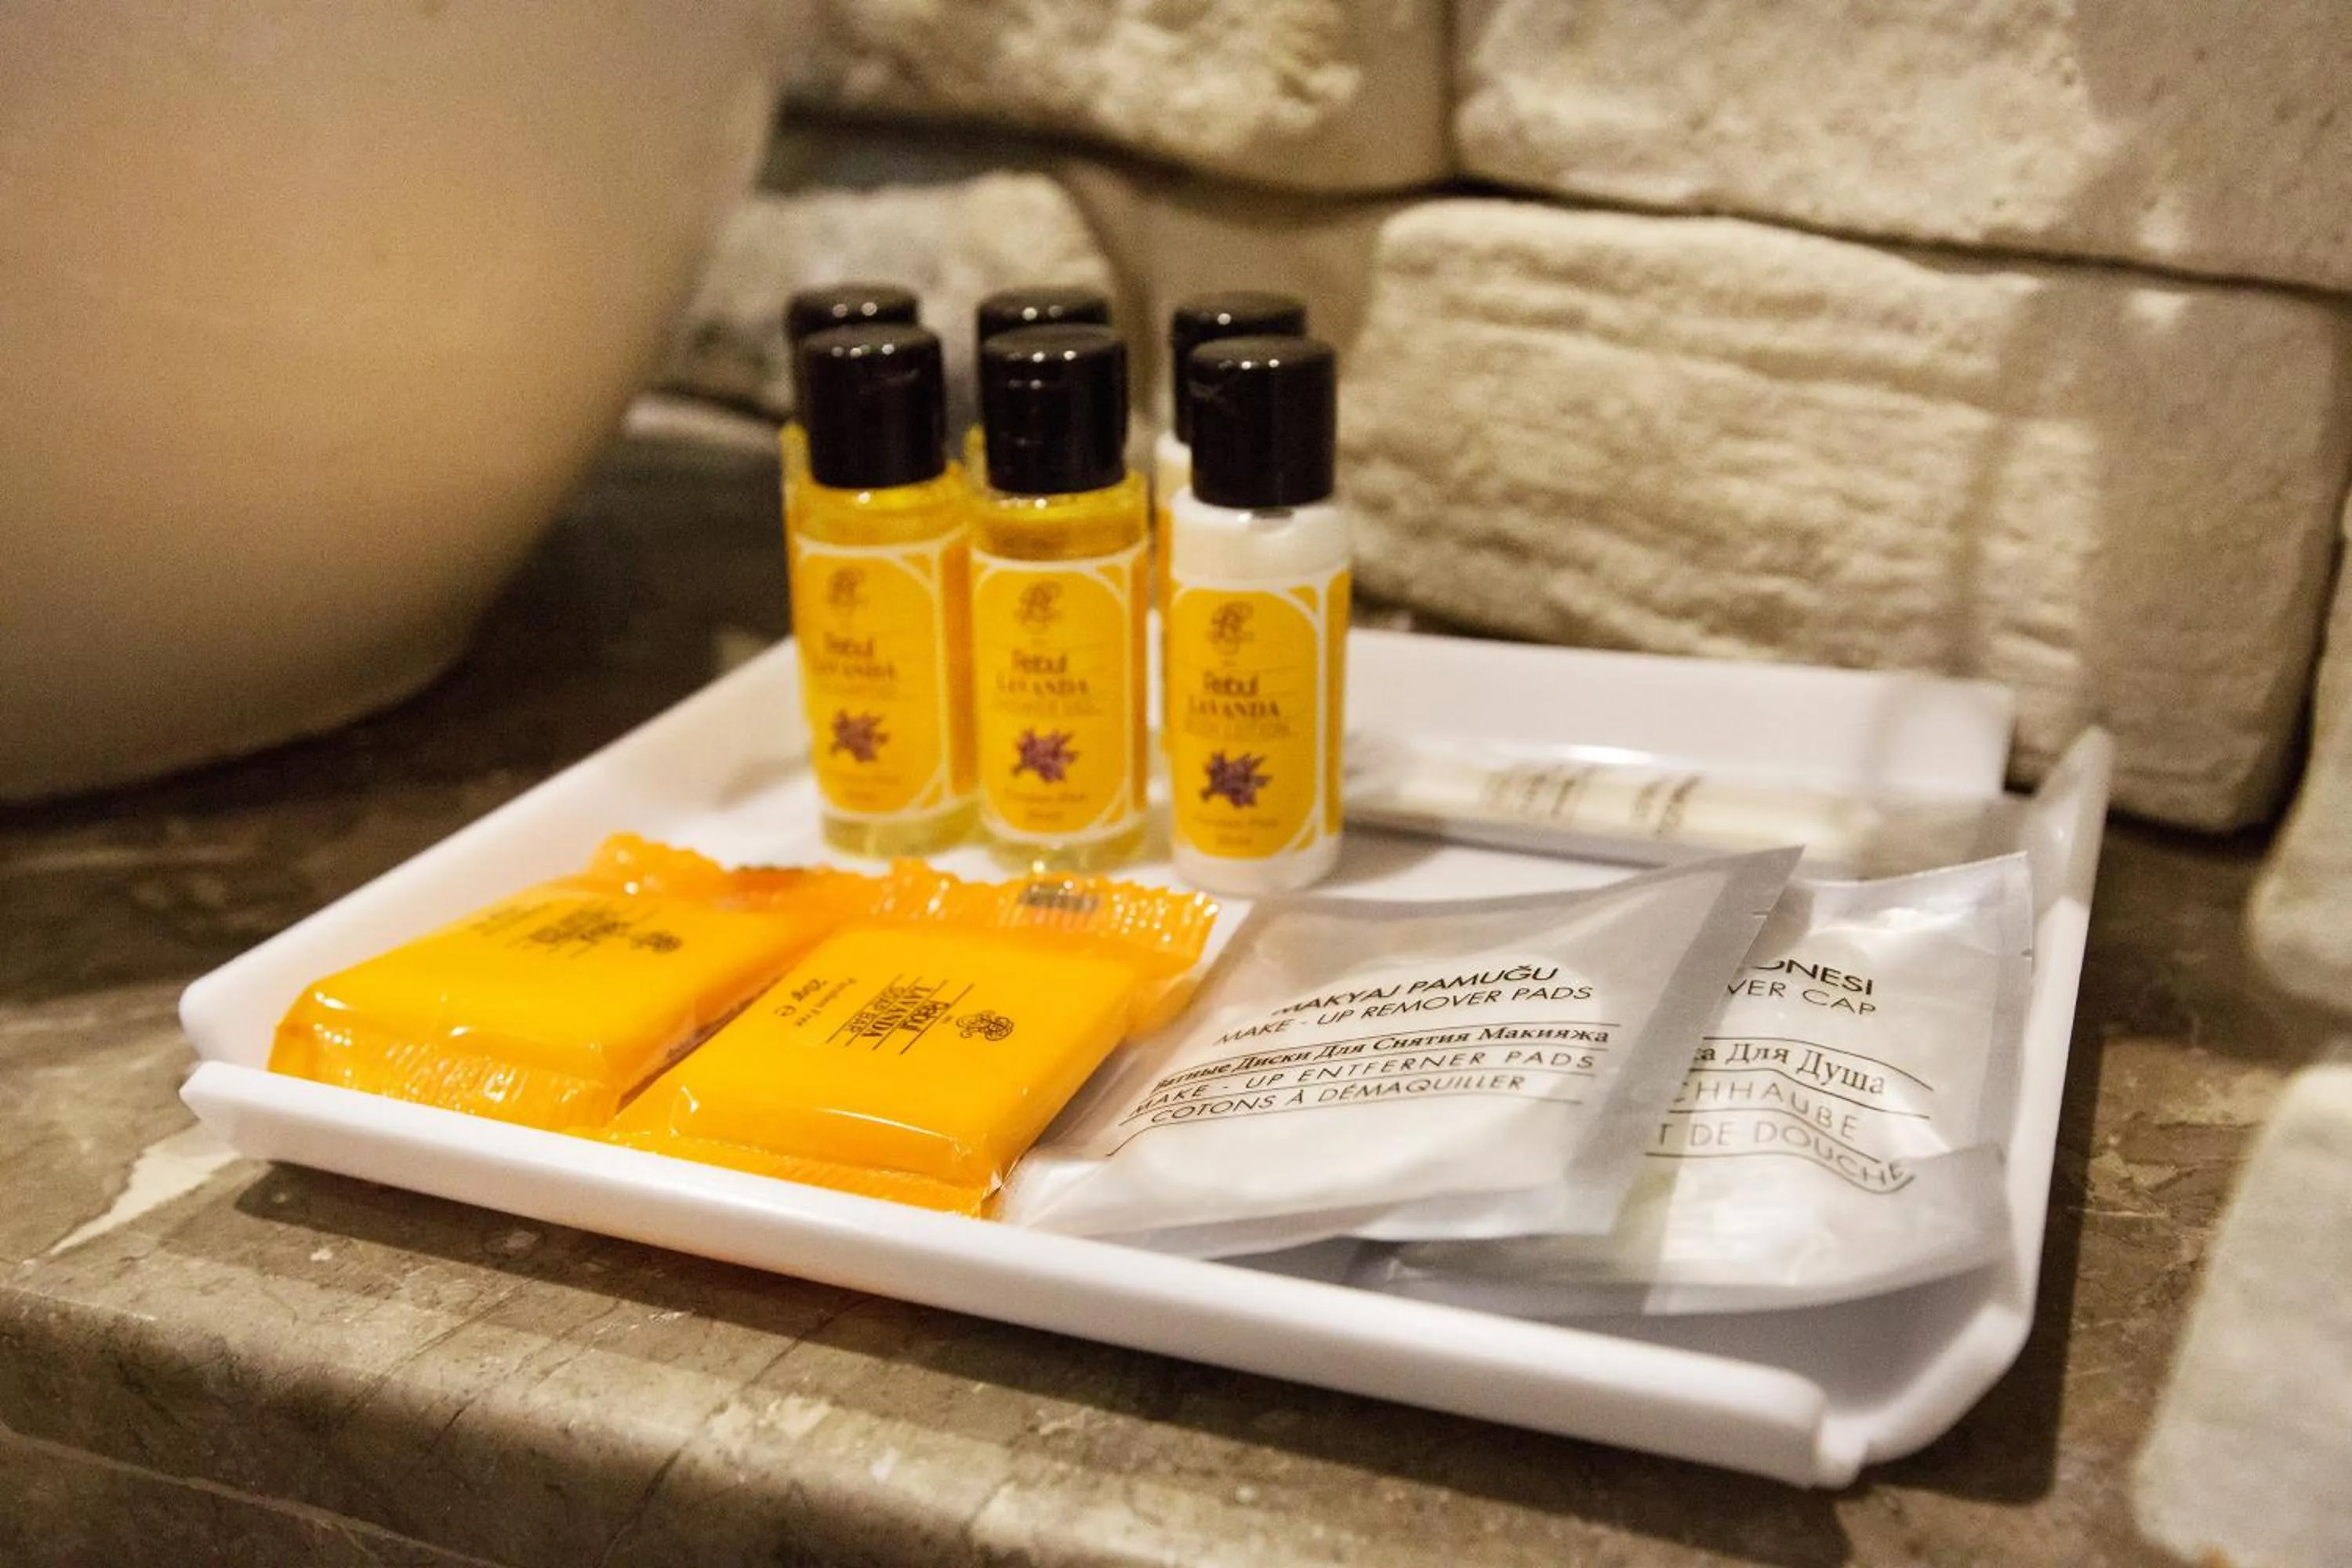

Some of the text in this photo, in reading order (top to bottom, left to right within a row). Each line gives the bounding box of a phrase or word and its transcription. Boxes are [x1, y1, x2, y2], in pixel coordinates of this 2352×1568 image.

[1406, 964, 1559, 994] PAMUĞU
[1802, 988, 1877, 1017] CAP
[1212, 1018, 1296, 1047] MAKE
[1316, 1009, 1356, 1025] UP
[1360, 989, 1502, 1019] REMOVER
[1511, 985, 1594, 1001] PADS
[1230, 1050, 1313, 1074] Диски
[1312, 1043, 1367, 1062] Для
[1372, 1031, 1472, 1052] Снятия
[1475, 1025, 1610, 1044] Макияжа
[1245, 1073, 1285, 1090] UP
[1298, 1051, 1486, 1083] ENTFERNER
[1504, 1050, 1595, 1069] PADS
[1725, 1043, 1789, 1065] Для
[1796, 1048, 1886, 1096] Душа
[1150, 1094, 1277, 1124] COTONS
[1317, 1074, 1526, 1103] DÉMAQUILLER
[1690, 1123, 1734, 1147] DE
[1754, 1120, 1906, 1187] DOUCHE
